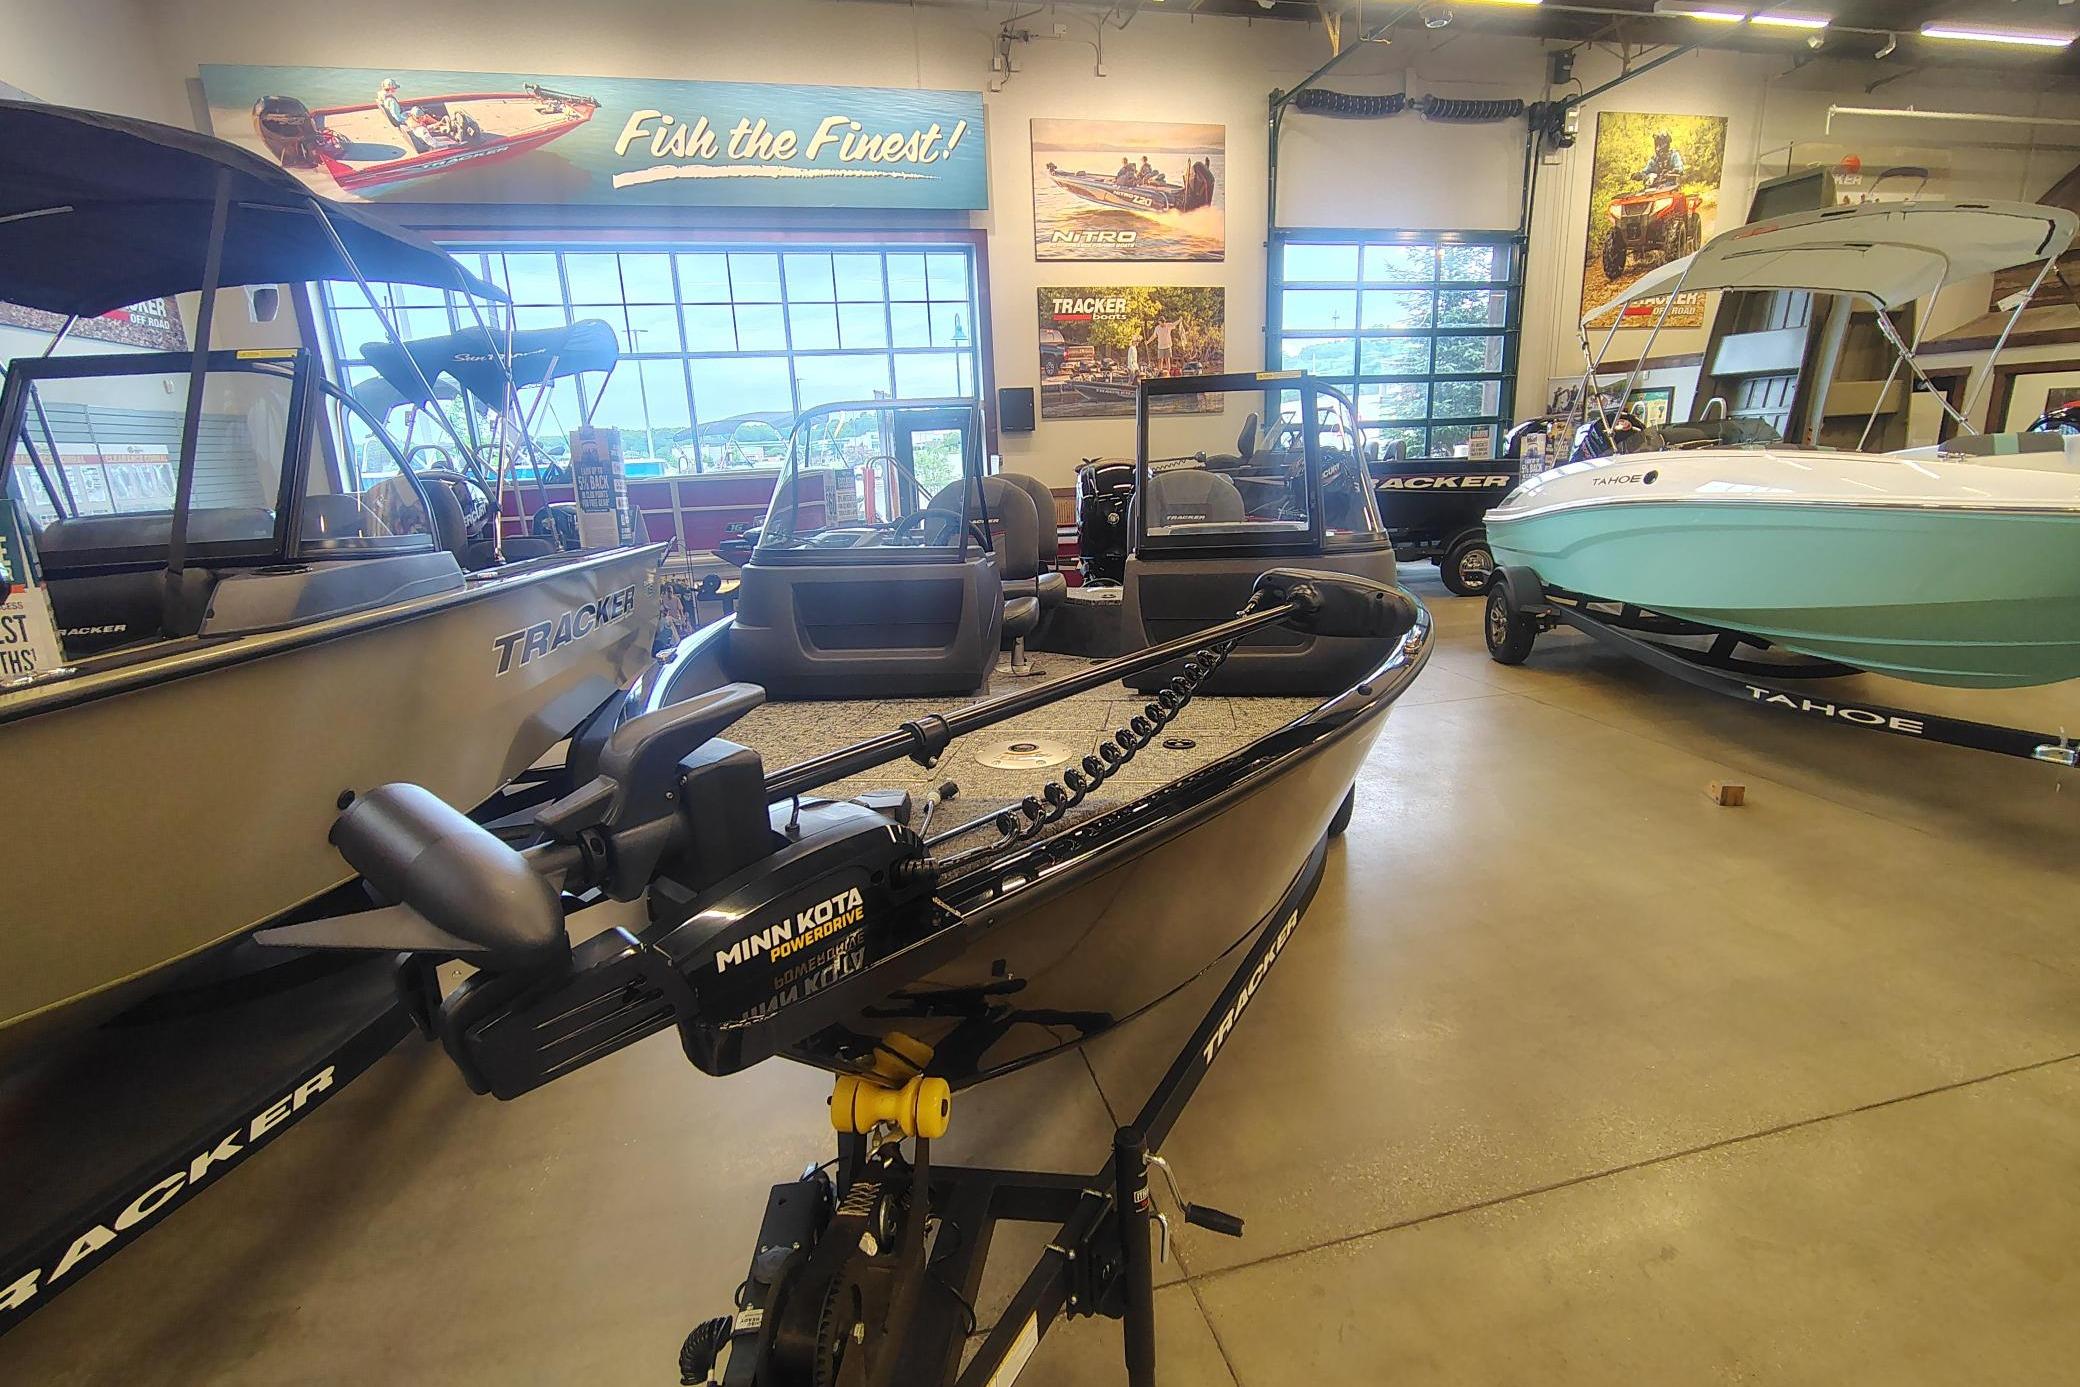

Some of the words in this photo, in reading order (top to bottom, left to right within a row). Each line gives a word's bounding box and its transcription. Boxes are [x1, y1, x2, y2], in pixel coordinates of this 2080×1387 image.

[614, 109, 719, 159] Fish
[728, 117, 799, 160] the
[805, 115, 967, 164] Finest!
[1053, 298, 1126, 314] TRACKER
[1671, 307, 1696, 315] ROAD
[129, 313, 146, 325] OFF
[148, 316, 170, 329] ROAD
[577, 475, 589, 491] 5%
[590, 475, 609, 490] BACK
[1371, 475, 1510, 489] ACKER
[1592, 474, 1643, 486] TAHOE
[58, 624, 127, 637] RACKER
[492, 584, 636, 677] TRACKER
[1746, 685, 1924, 734] TAHOE
[716, 919, 791, 973] MINN
[797, 887, 863, 932] KOTA
[770, 906, 865, 964] POWERDRIVE
[1203, 908, 1299, 1066] TRACKER
